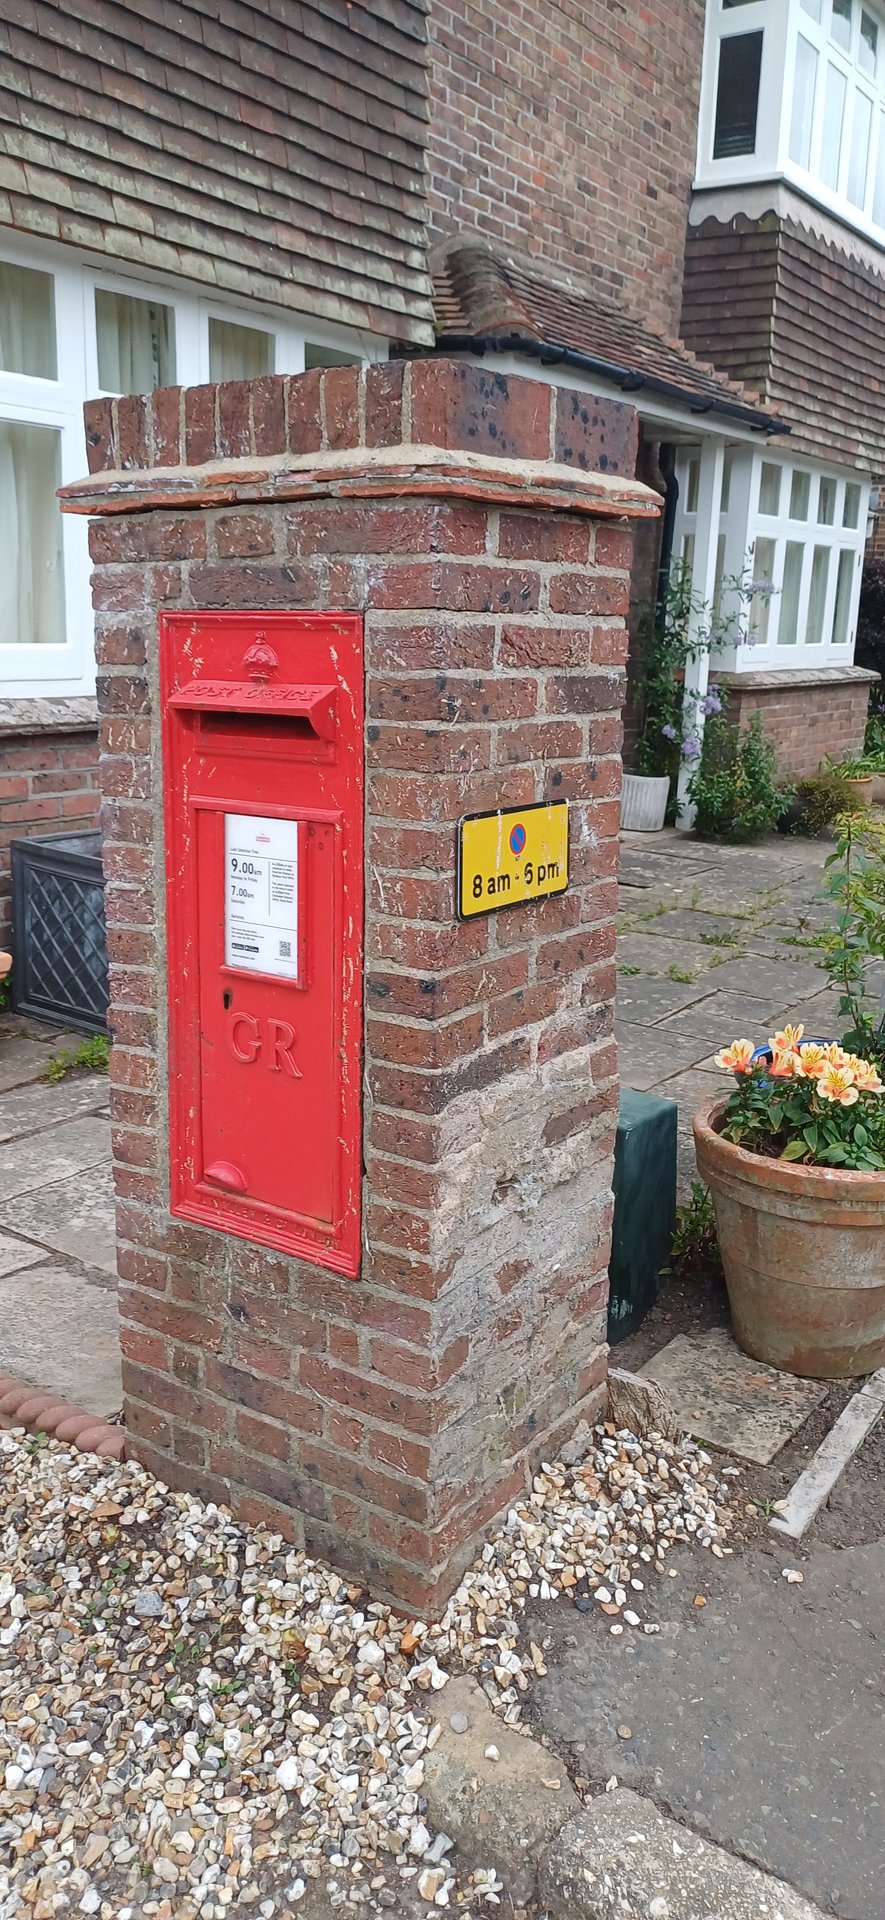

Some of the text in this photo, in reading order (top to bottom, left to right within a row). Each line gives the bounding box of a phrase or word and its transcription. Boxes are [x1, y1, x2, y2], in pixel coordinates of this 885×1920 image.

[179, 686, 321, 701] POST OFFICE
[225, 1012, 303, 1079] GR
